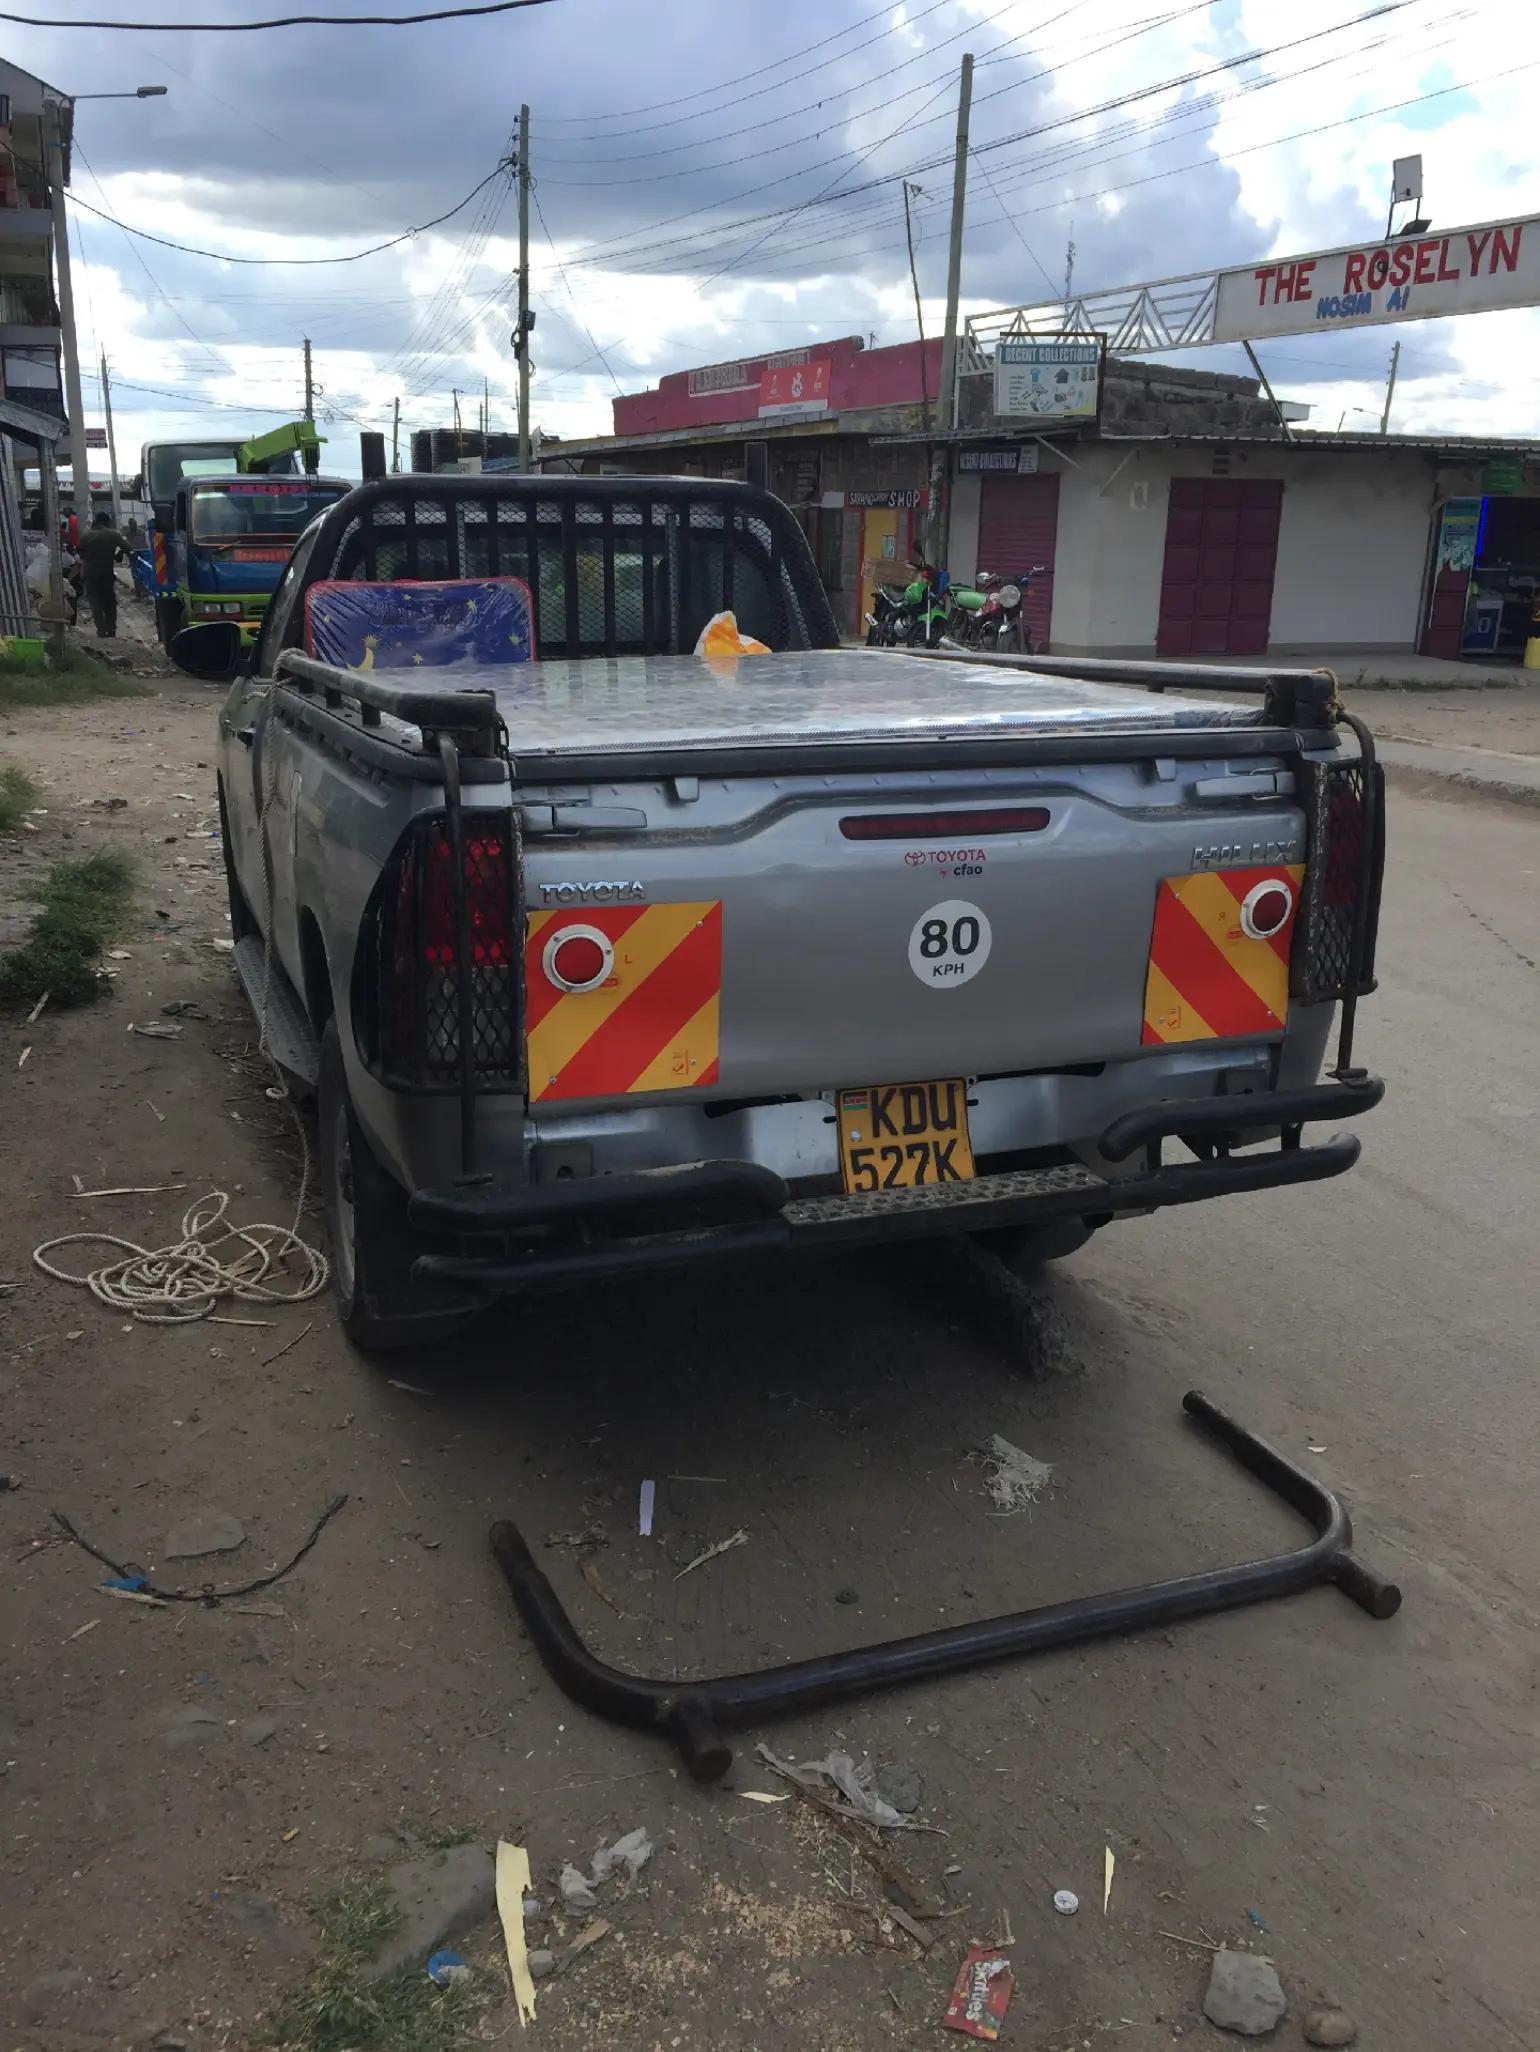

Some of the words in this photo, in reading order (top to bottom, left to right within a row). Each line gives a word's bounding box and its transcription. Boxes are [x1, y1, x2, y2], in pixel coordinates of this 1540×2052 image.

[1255, 261, 1316, 305] THE
[1344, 226, 1523, 294] ROSELYN
[1039, 347, 1097, 361] COLLECTIONS
[888, 490, 920, 507] SHOP
[928, 849, 986, 863] TOYOTA
[1190, 840, 1297, 869] HILUX
[953, 864, 983, 876] cfao
[539, 881, 646, 903] TOYOTA
[920, 916, 980, 958] 80
[933, 963, 965, 977] KPH
[870, 1083, 957, 1138] KDU
[850, 1138, 962, 1192] 527K
